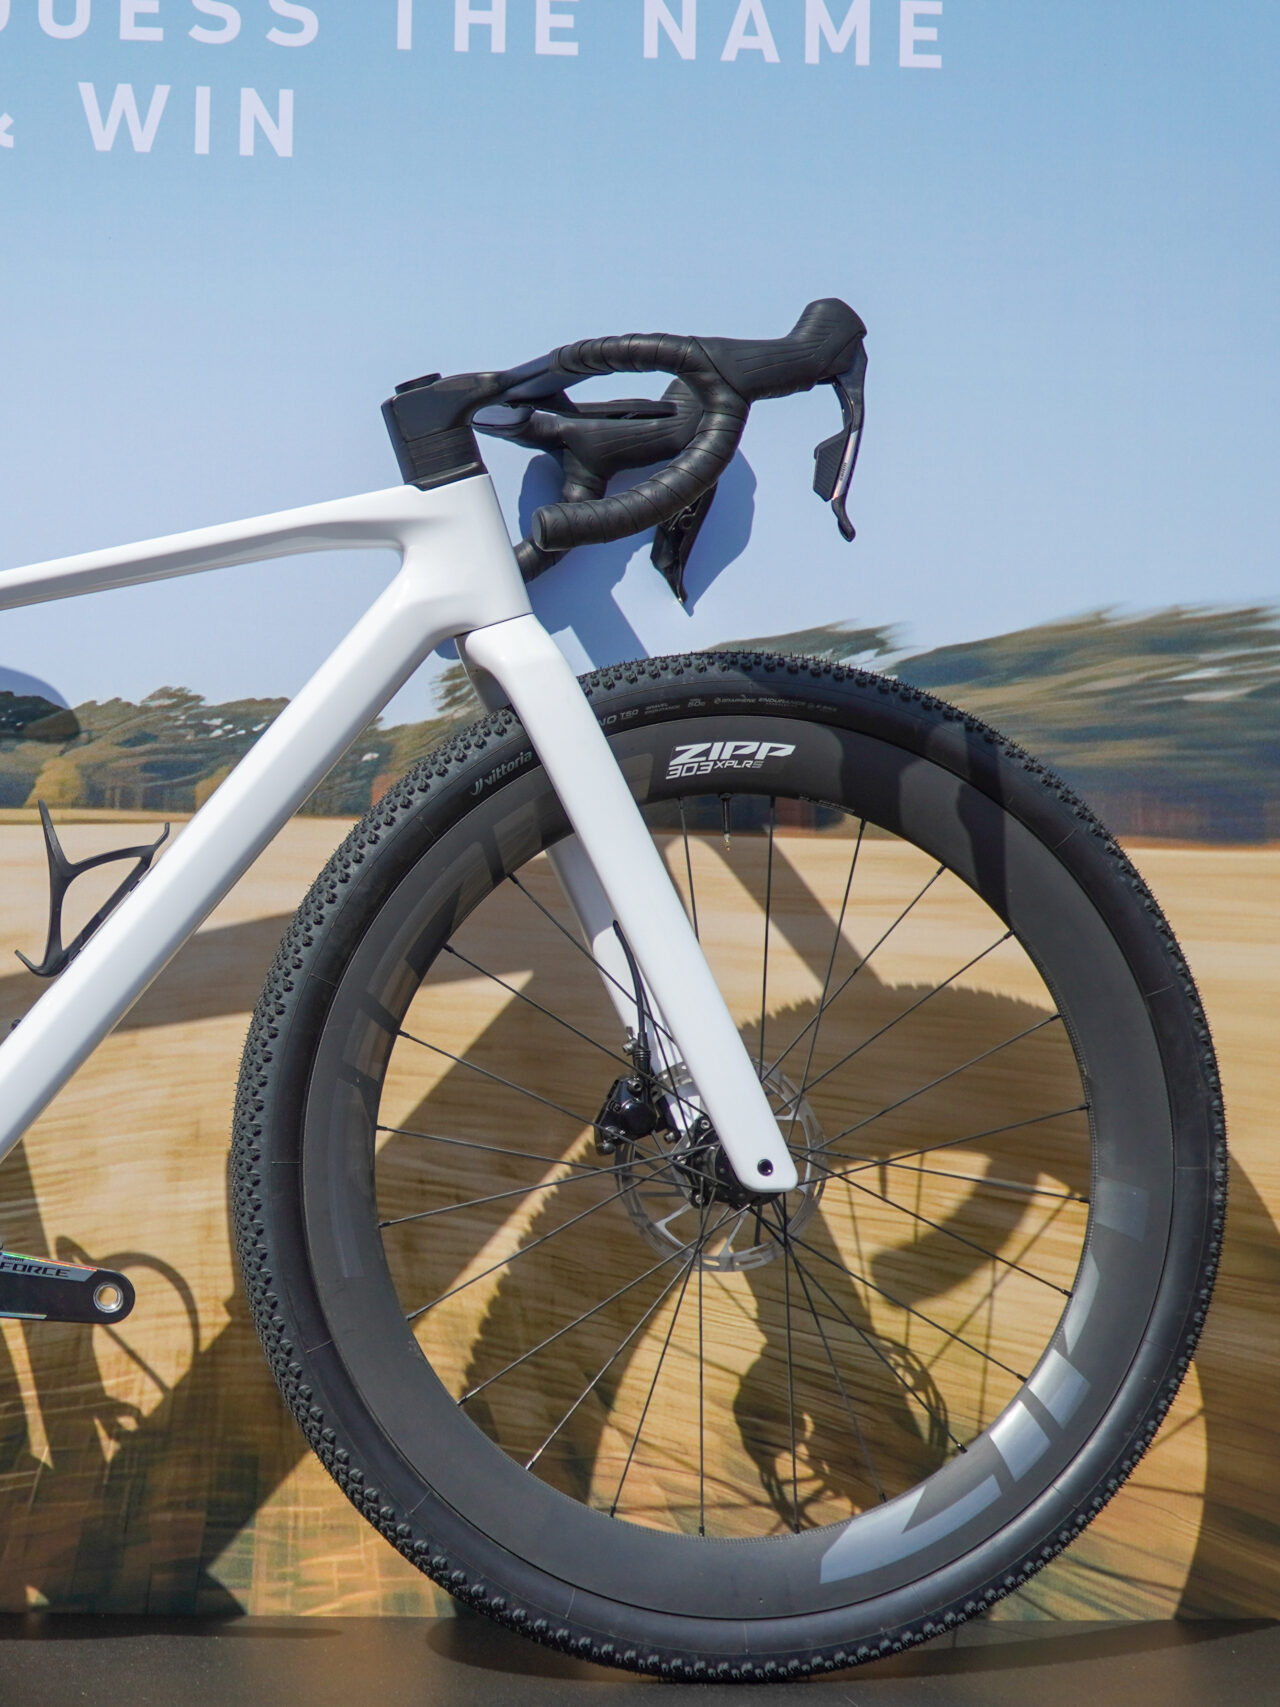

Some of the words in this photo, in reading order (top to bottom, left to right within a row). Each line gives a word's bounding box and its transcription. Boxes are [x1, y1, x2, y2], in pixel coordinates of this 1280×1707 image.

[396, 0, 579, 56] THE
[643, 0, 943, 68] NAME
[78, 81, 294, 157] WIN
[484, 751, 533, 785] vittoria
[670, 741, 796, 766] ZIPP
[665, 761, 714, 780] 303
[0, 1261, 71, 1278] FORCE
